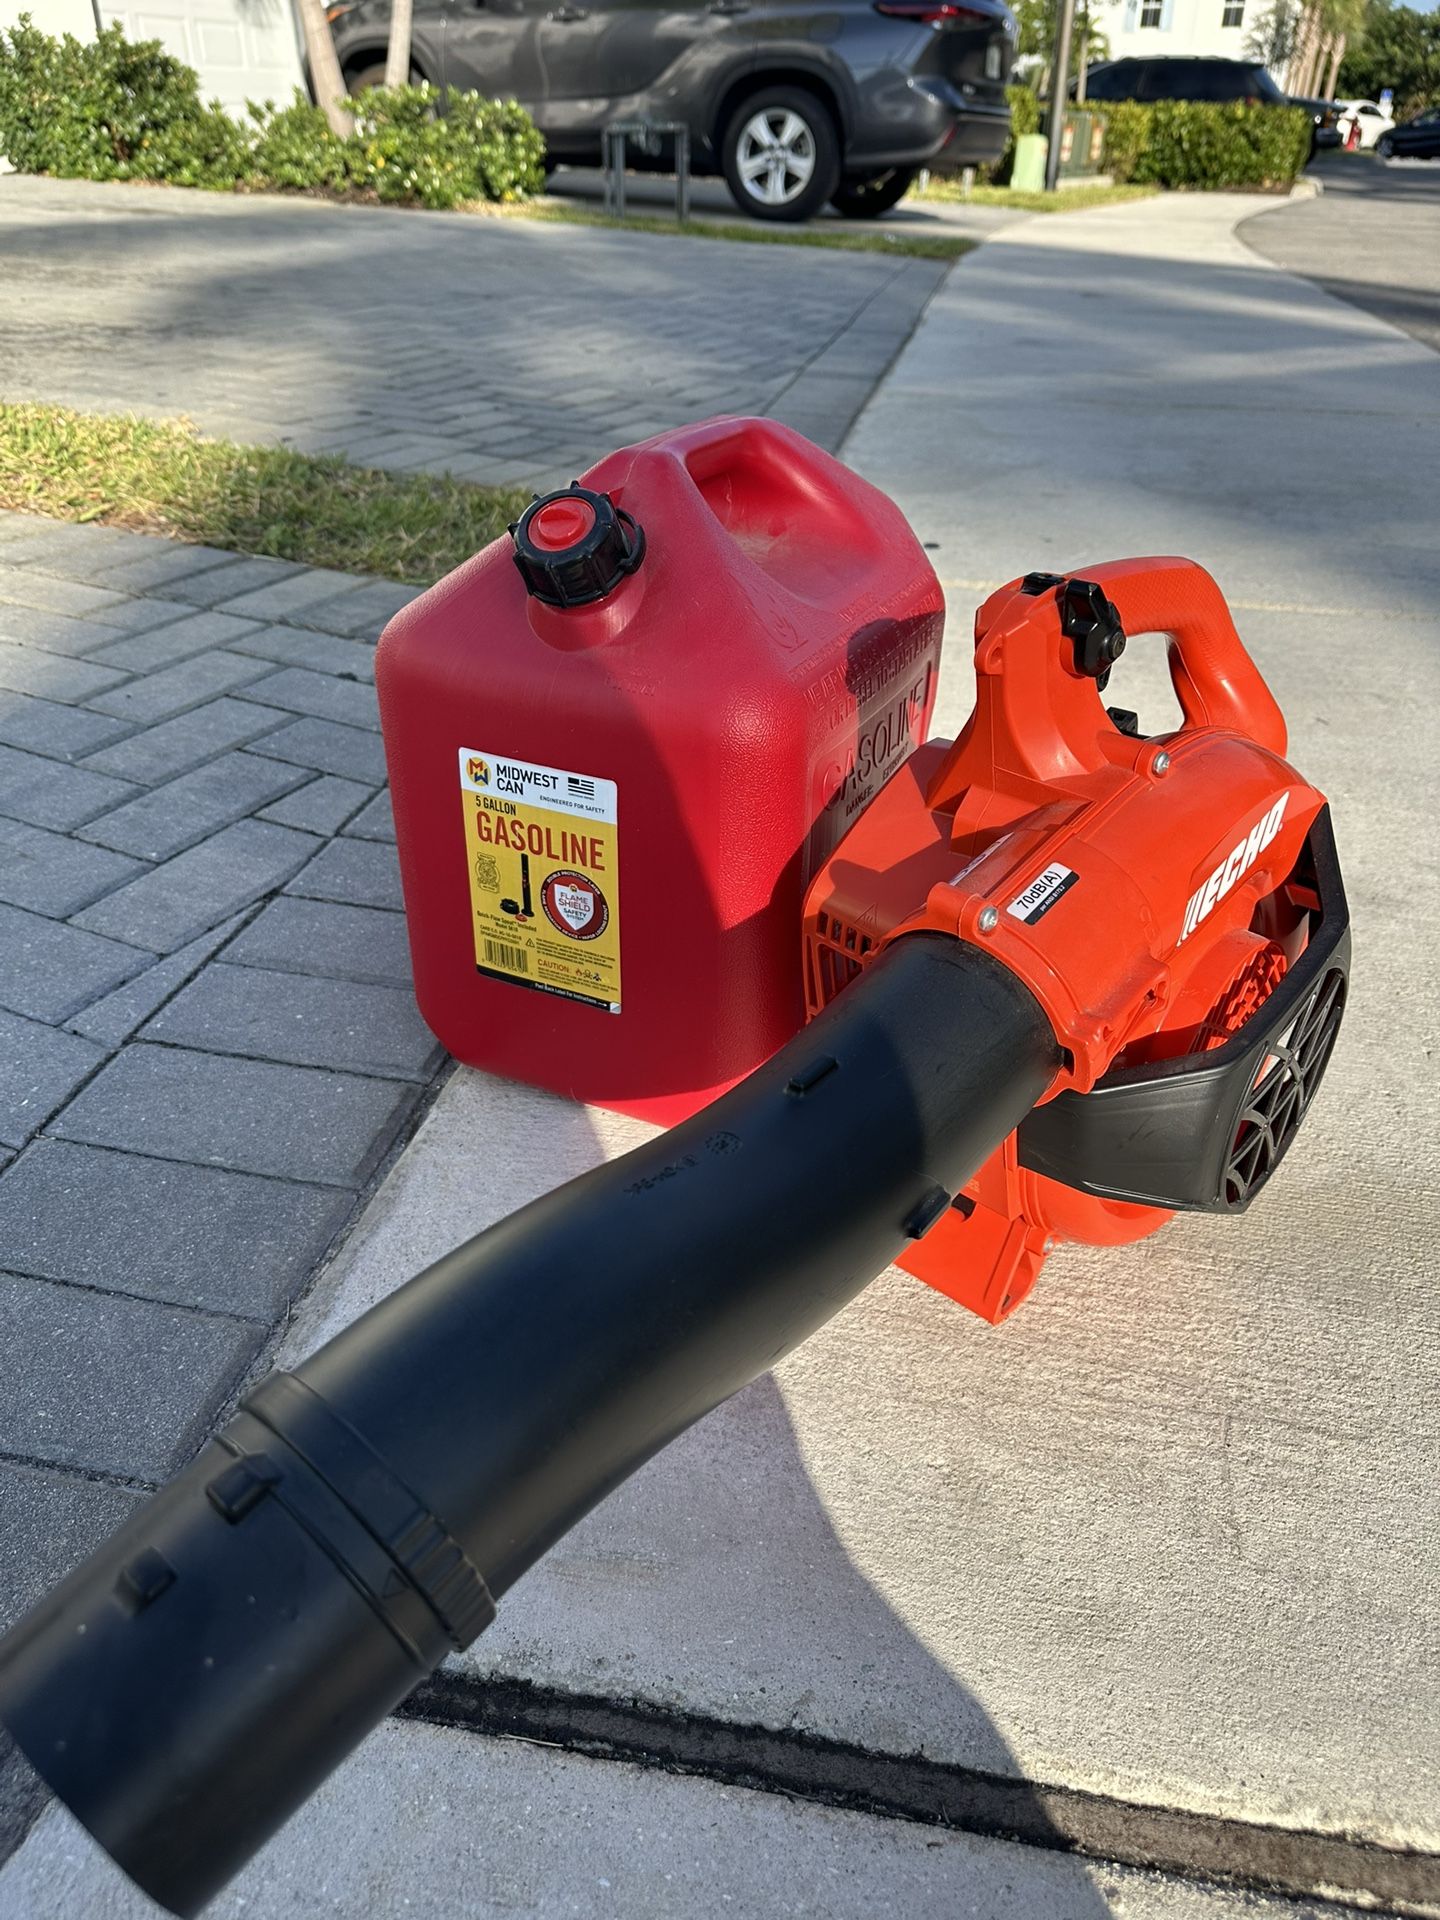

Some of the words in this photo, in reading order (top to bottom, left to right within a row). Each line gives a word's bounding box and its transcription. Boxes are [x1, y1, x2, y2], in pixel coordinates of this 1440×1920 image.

[821, 677, 924, 812] GASOLINE
[496, 763, 559, 790] MIDWEST
[497, 778, 524, 795] CAN
[475, 795, 482, 807] 5
[483, 797, 517, 816] GALLON
[539, 795, 573, 808] ENGINEERED
[574, 801, 585, 811] FOR
[585, 804, 605, 815] SAFETY
[476, 811, 606, 871] GASOLINE
[1192, 790, 1291, 928] ECHO
[560, 891, 588, 904] FLAME
[1016, 870, 1063, 909] 70dB(A)
[558, 897, 591, 913] SHIELD
[563, 907, 587, 918] SAFETY
